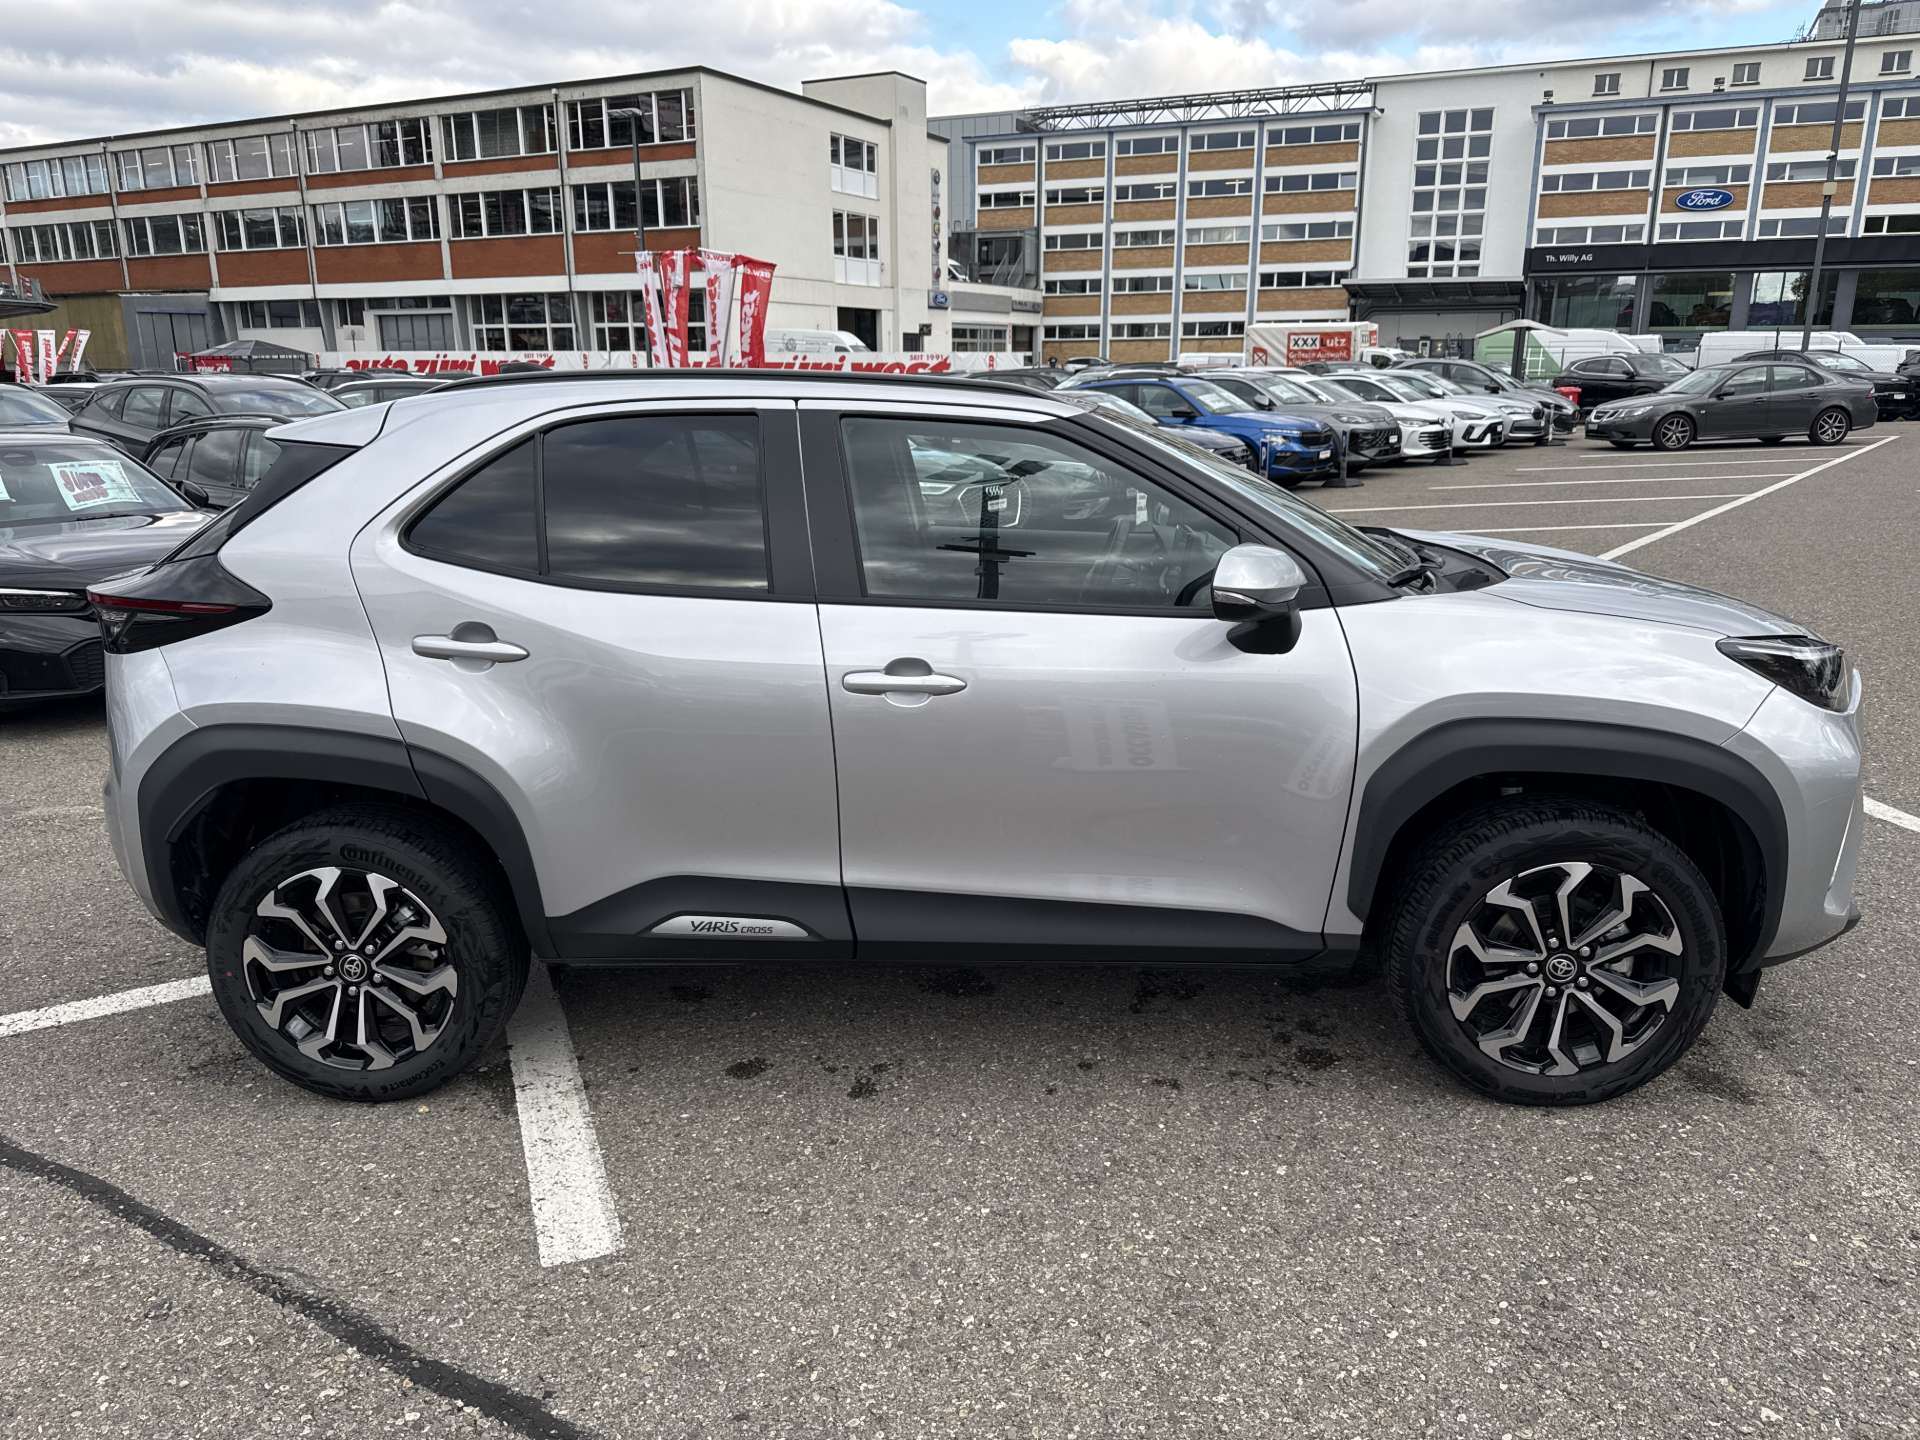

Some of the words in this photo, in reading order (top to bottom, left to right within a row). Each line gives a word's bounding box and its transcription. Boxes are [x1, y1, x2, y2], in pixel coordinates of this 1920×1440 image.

[1687, 192, 1723, 206] Ford
[1559, 254, 1579, 263] Willy
[1580, 253, 1593, 261] AG
[341, 844, 438, 896] Continental
[741, 926, 773, 934] CROSS
